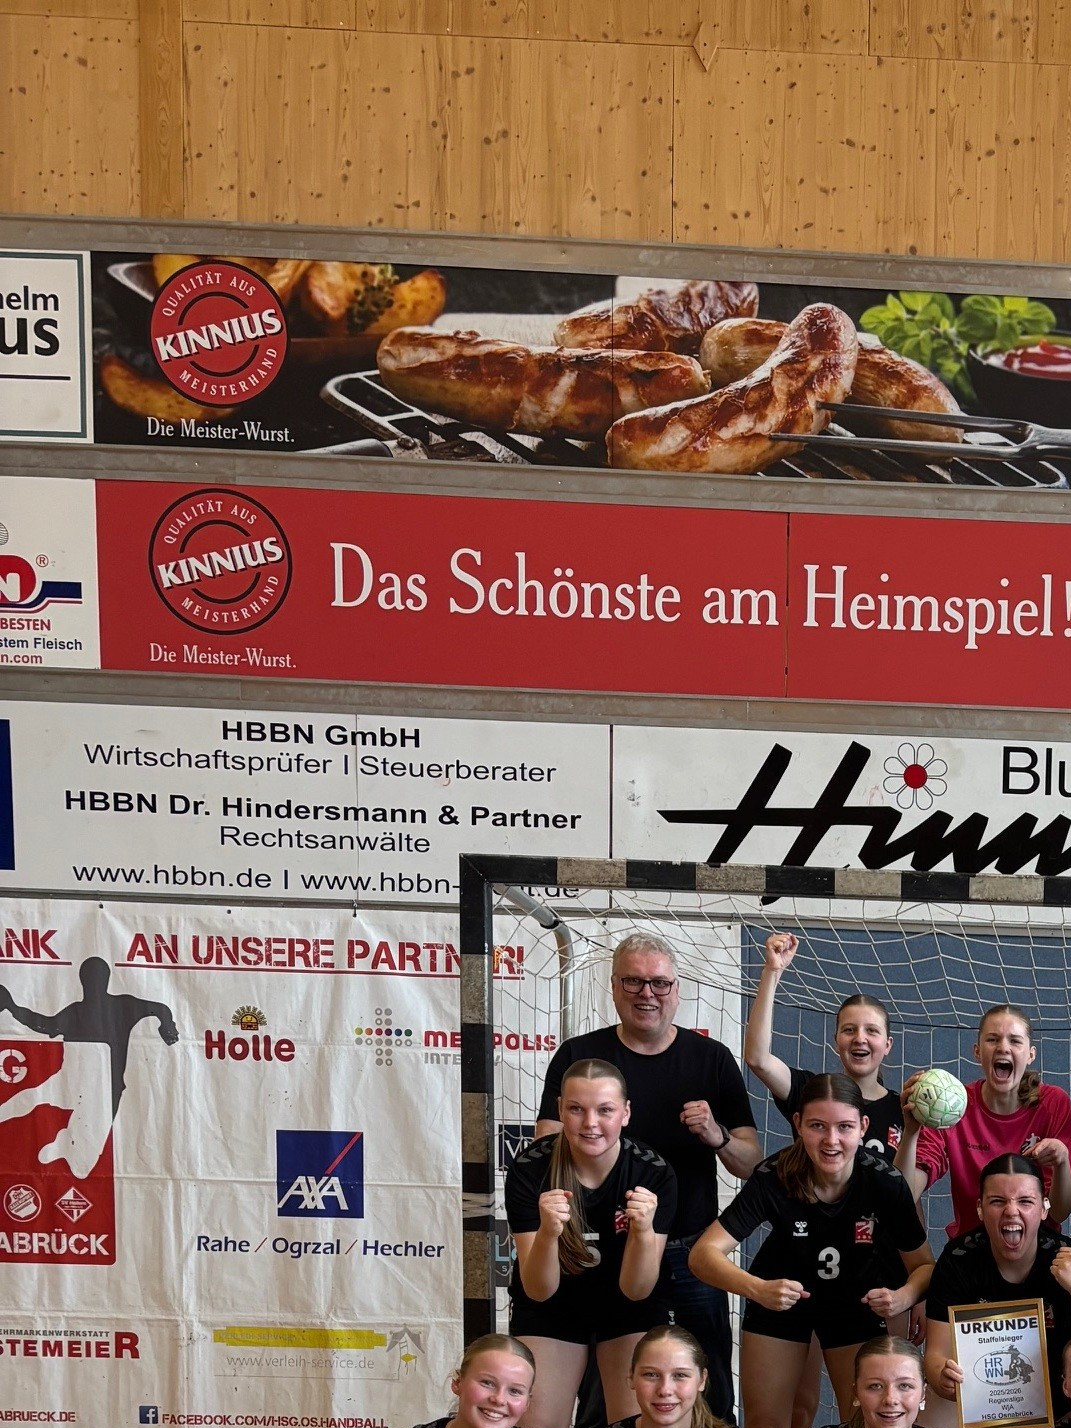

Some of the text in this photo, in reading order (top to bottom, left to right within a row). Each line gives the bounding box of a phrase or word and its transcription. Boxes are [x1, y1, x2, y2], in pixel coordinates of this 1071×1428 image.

[163, 271, 257, 317] QUALITÄT AUS
[155, 308, 283, 362] KINNIUS
[179, 347, 278, 397] MEISTERHAND
[147, 417, 295, 443] Die Meister-Wurst.
[163, 500, 258, 545] QUALITÄT AUS
[157, 536, 284, 590] KINNIUS
[180, 575, 279, 624] MEISTERHAND
[329, 542, 428, 611] Das
[448, 547, 681, 623] Schönste
[702, 583, 780, 628] am
[33, 637, 83, 651] Fleisch
[150, 642, 297, 668] Die Meister-Wurst.
[221, 721, 421, 749] HBBN GmbH
[84, 743, 557, 783] Wirtschaftsprüfer Steuerberater
[65, 790, 582, 831] HBBN Dr. Hindersmann & Partner
[220, 825, 430, 854] Rechtsanwälte
[73, 863, 272, 891] www.hbbn.de
[127, 933, 179, 964] AN
[192, 936, 336, 968] UNSERE
[354, 939, 524, 976] PARTNR!
[205, 1029, 296, 1062] Holle
[277, 1175, 349, 1211] AXA
[197, 1236, 445, 1258] Rahe Ogrzal Hechler
[818, 1247, 840, 1279] 3
[961, 1317, 1038, 1334] URKUNDE
[978, 1335, 1023, 1344] Staffelsieger
[227, 1355, 374, 1369] www.verleih-service.de
[984, 1357, 1002, 1368] HR
[985, 1367, 1003, 1378] WN
[990, 1388, 1021, 1396] 2025/2026
[998, 1410, 1033, 1419] Osnabrück
